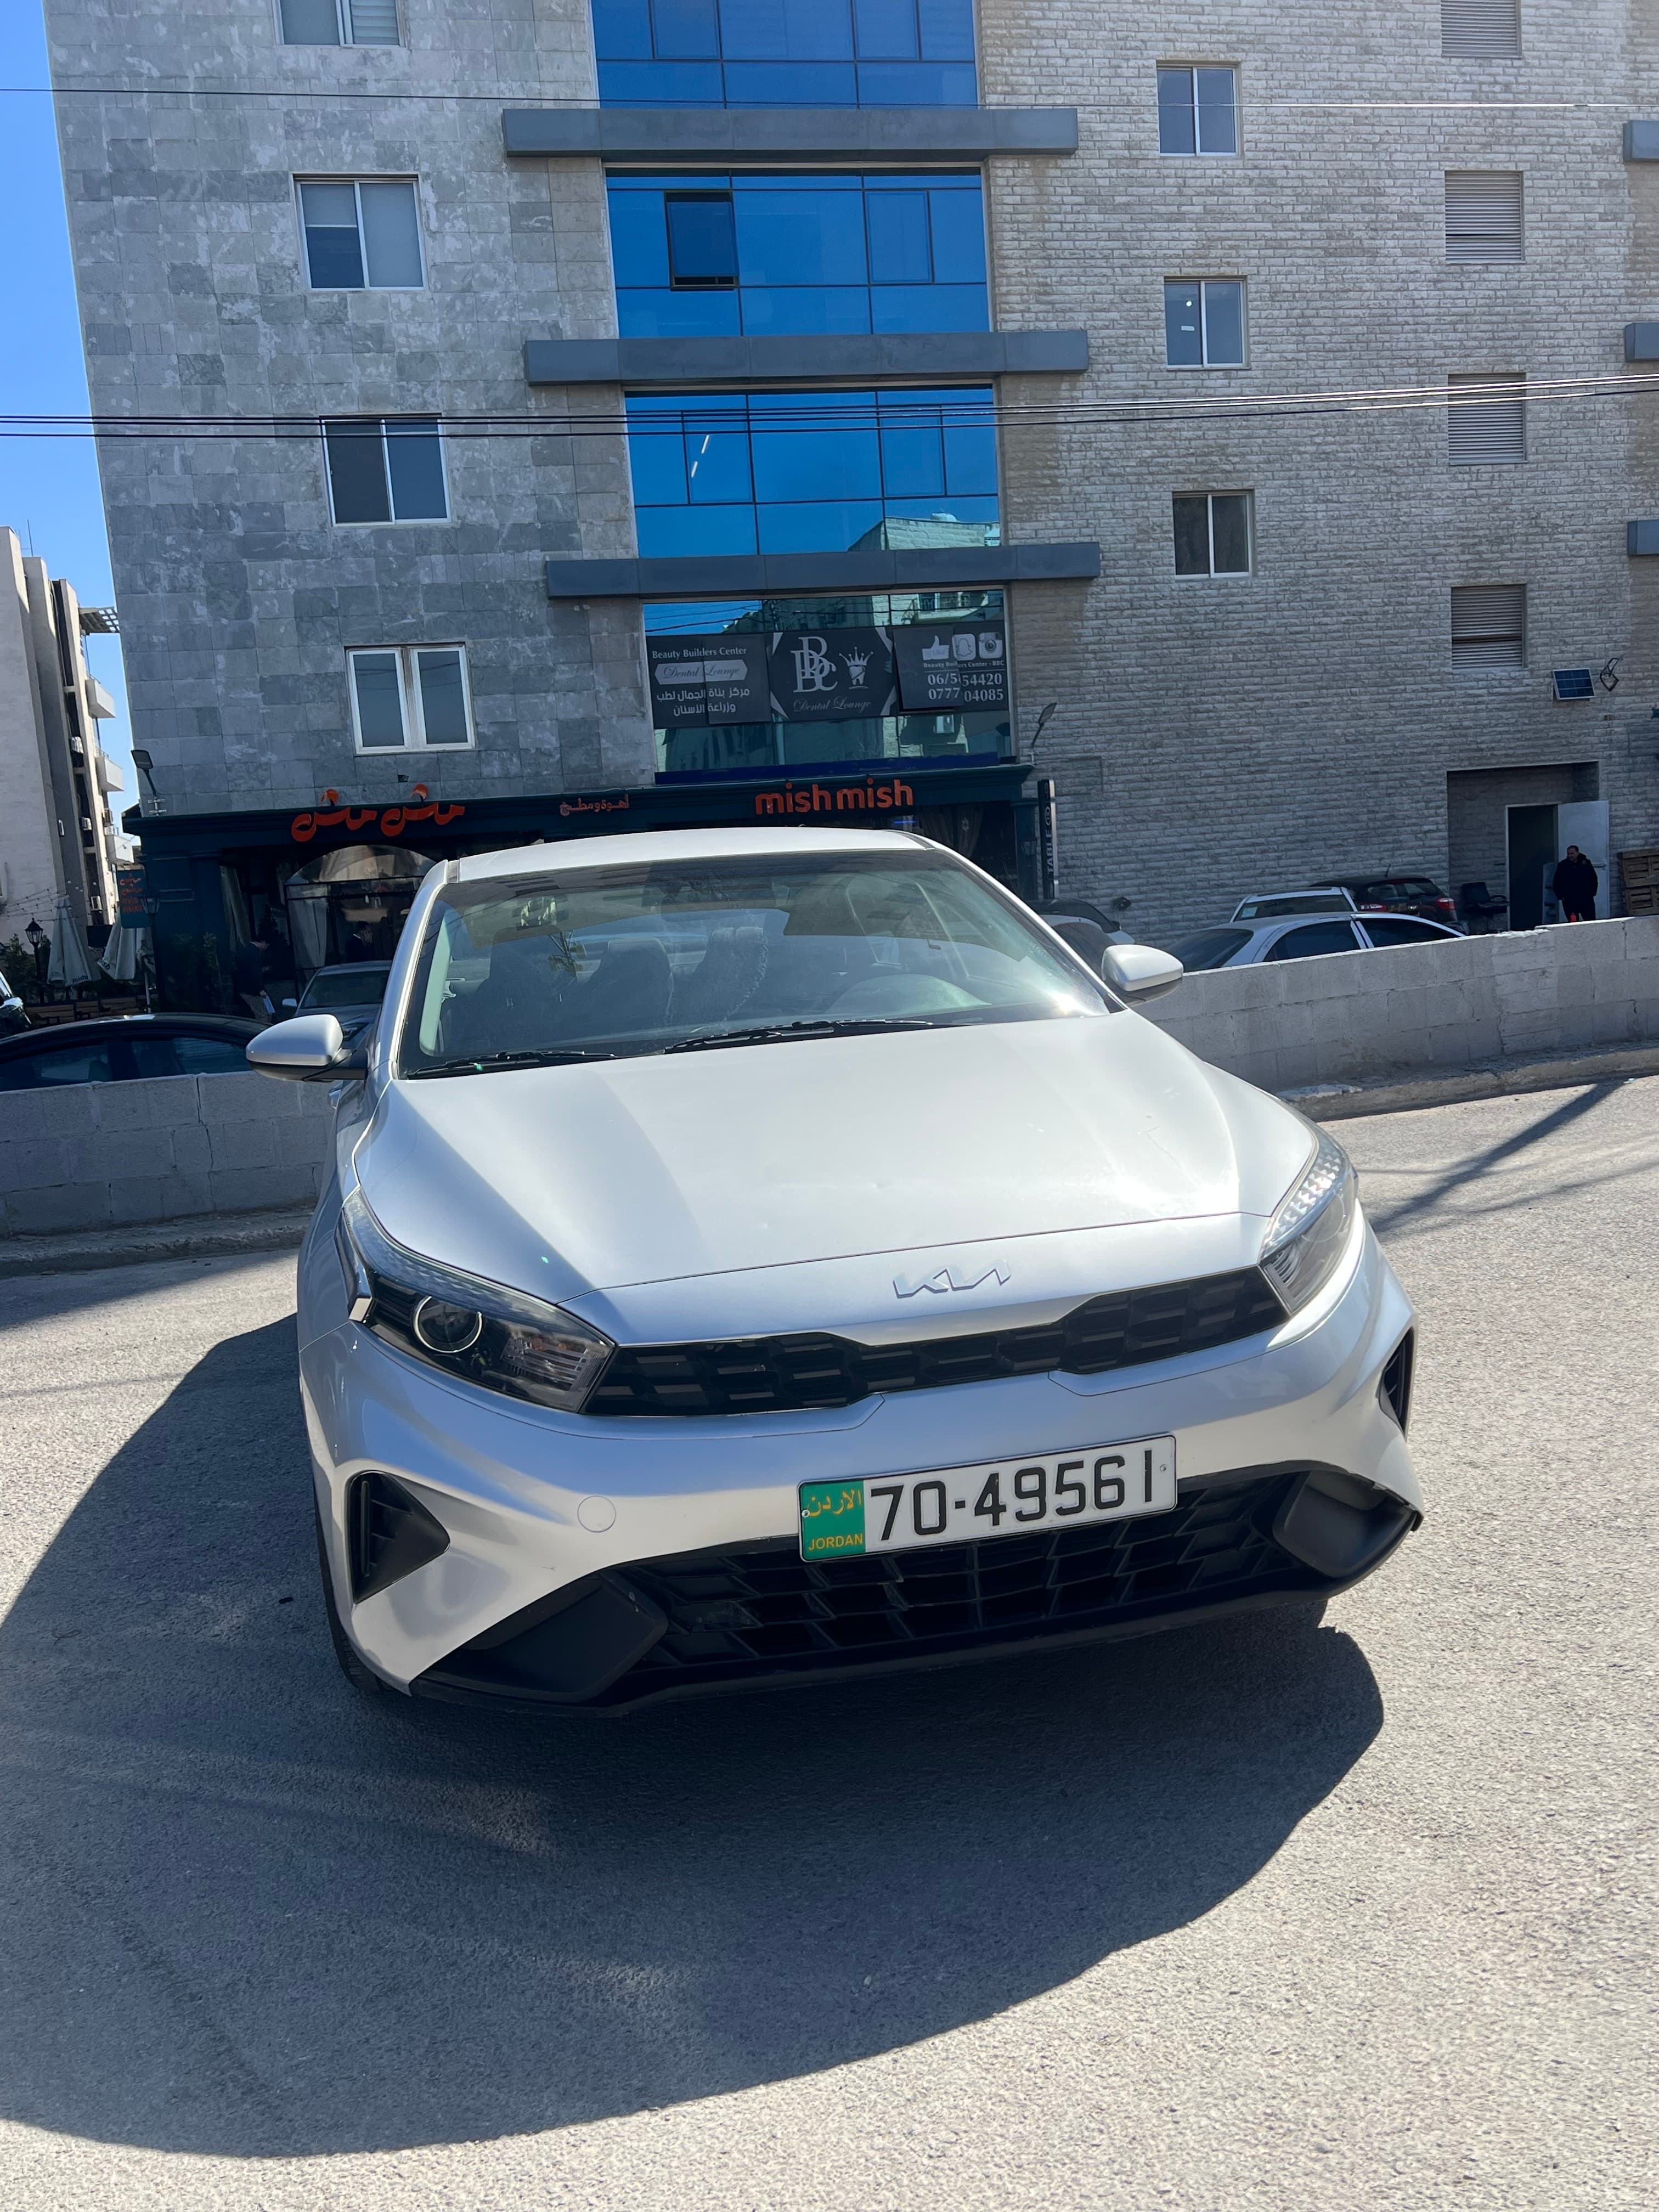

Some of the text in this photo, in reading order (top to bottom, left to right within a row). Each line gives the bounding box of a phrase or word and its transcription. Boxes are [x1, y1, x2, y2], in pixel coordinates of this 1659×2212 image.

[652, 647, 747, 660] Beauty Builders Center
[663, 663, 740, 680] Dental Lounge
[656, 691, 675, 702] لطب
[677, 689, 706, 701] الجمال
[729, 687, 750, 698] مركز
[707, 702, 736, 713] وزراعة
[793, 696, 872, 713] Dental Lounge
[755, 777, 913, 815] mish mish
[870, 1449, 1153, 1542] 70-49561
[808, 1533, 864, 1552] JORDAN
